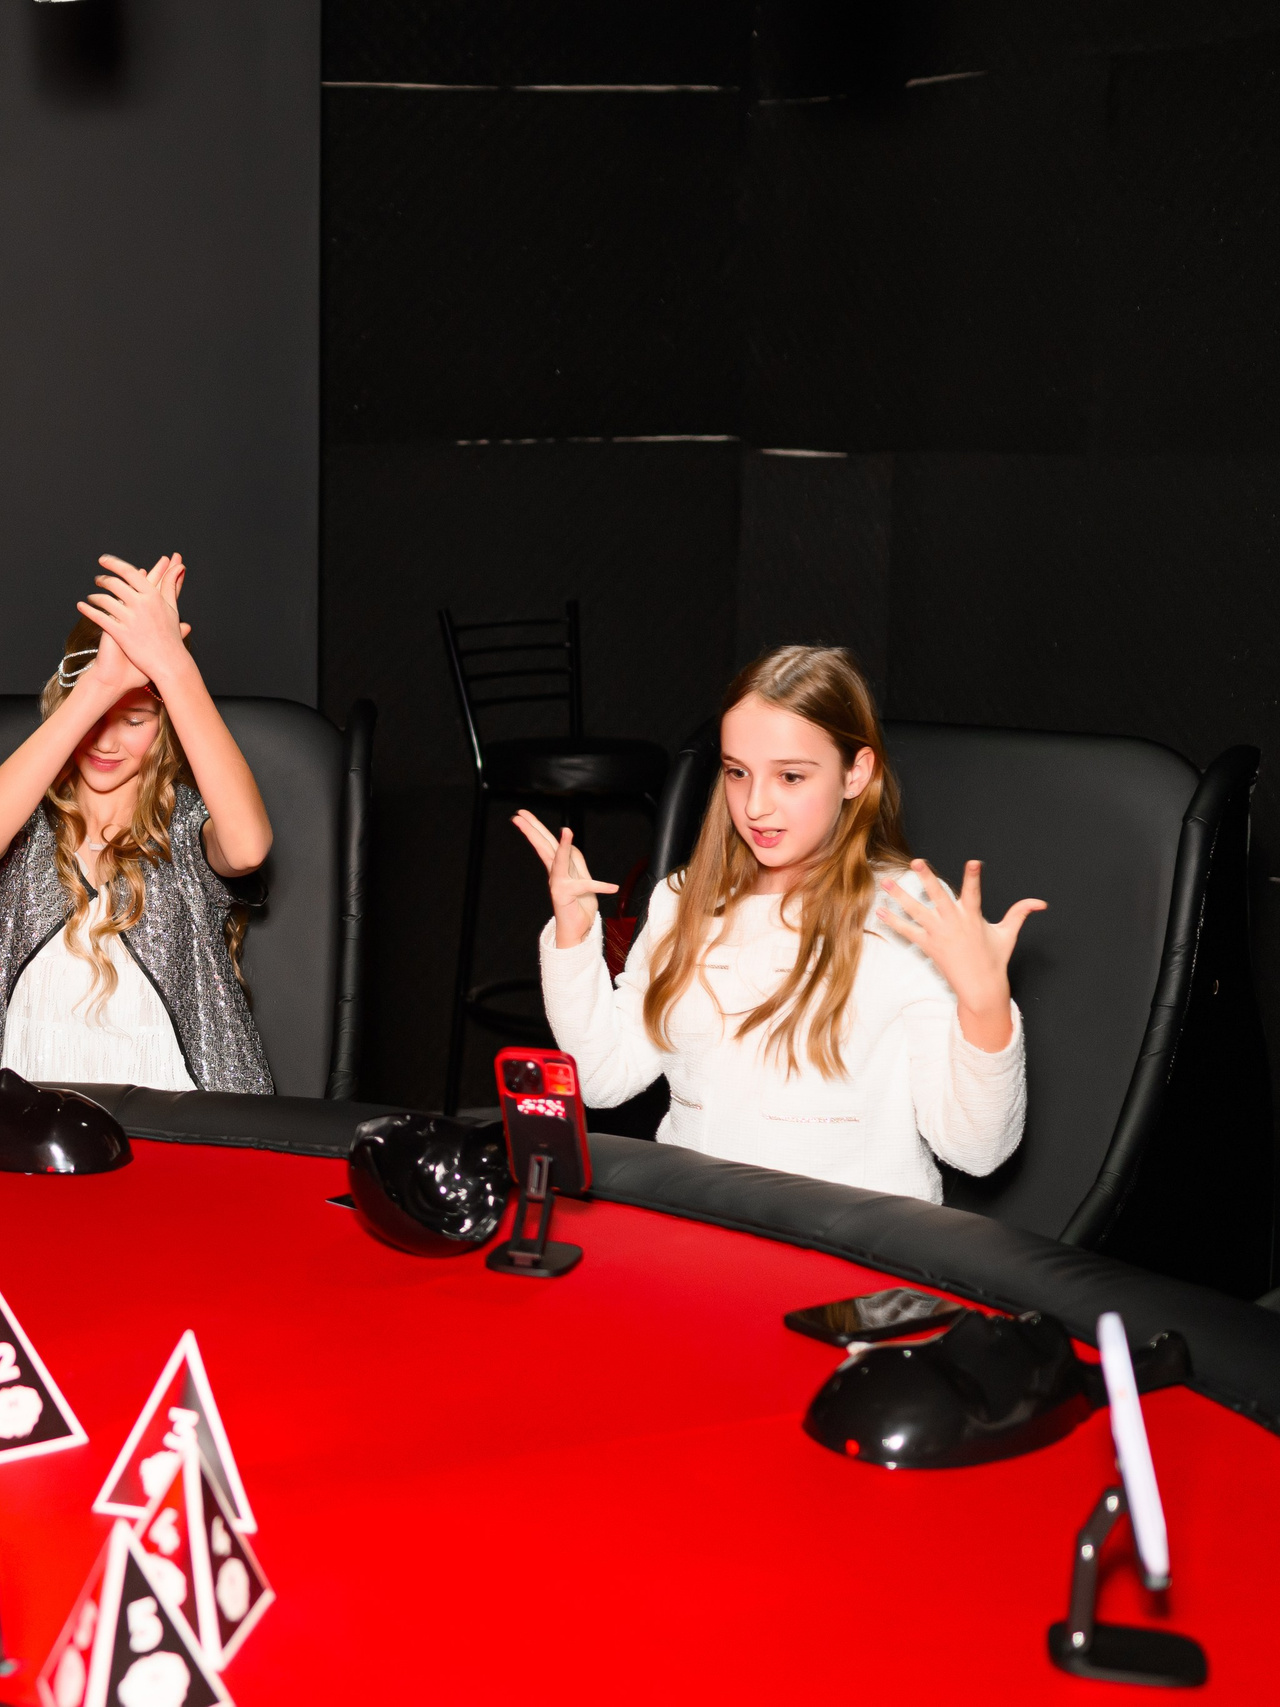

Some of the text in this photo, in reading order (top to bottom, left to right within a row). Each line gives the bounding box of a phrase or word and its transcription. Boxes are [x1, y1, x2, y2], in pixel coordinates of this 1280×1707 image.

[163, 1406, 200, 1451] 3
[148, 1507, 181, 1555] 4
[127, 1595, 164, 1653] 5
